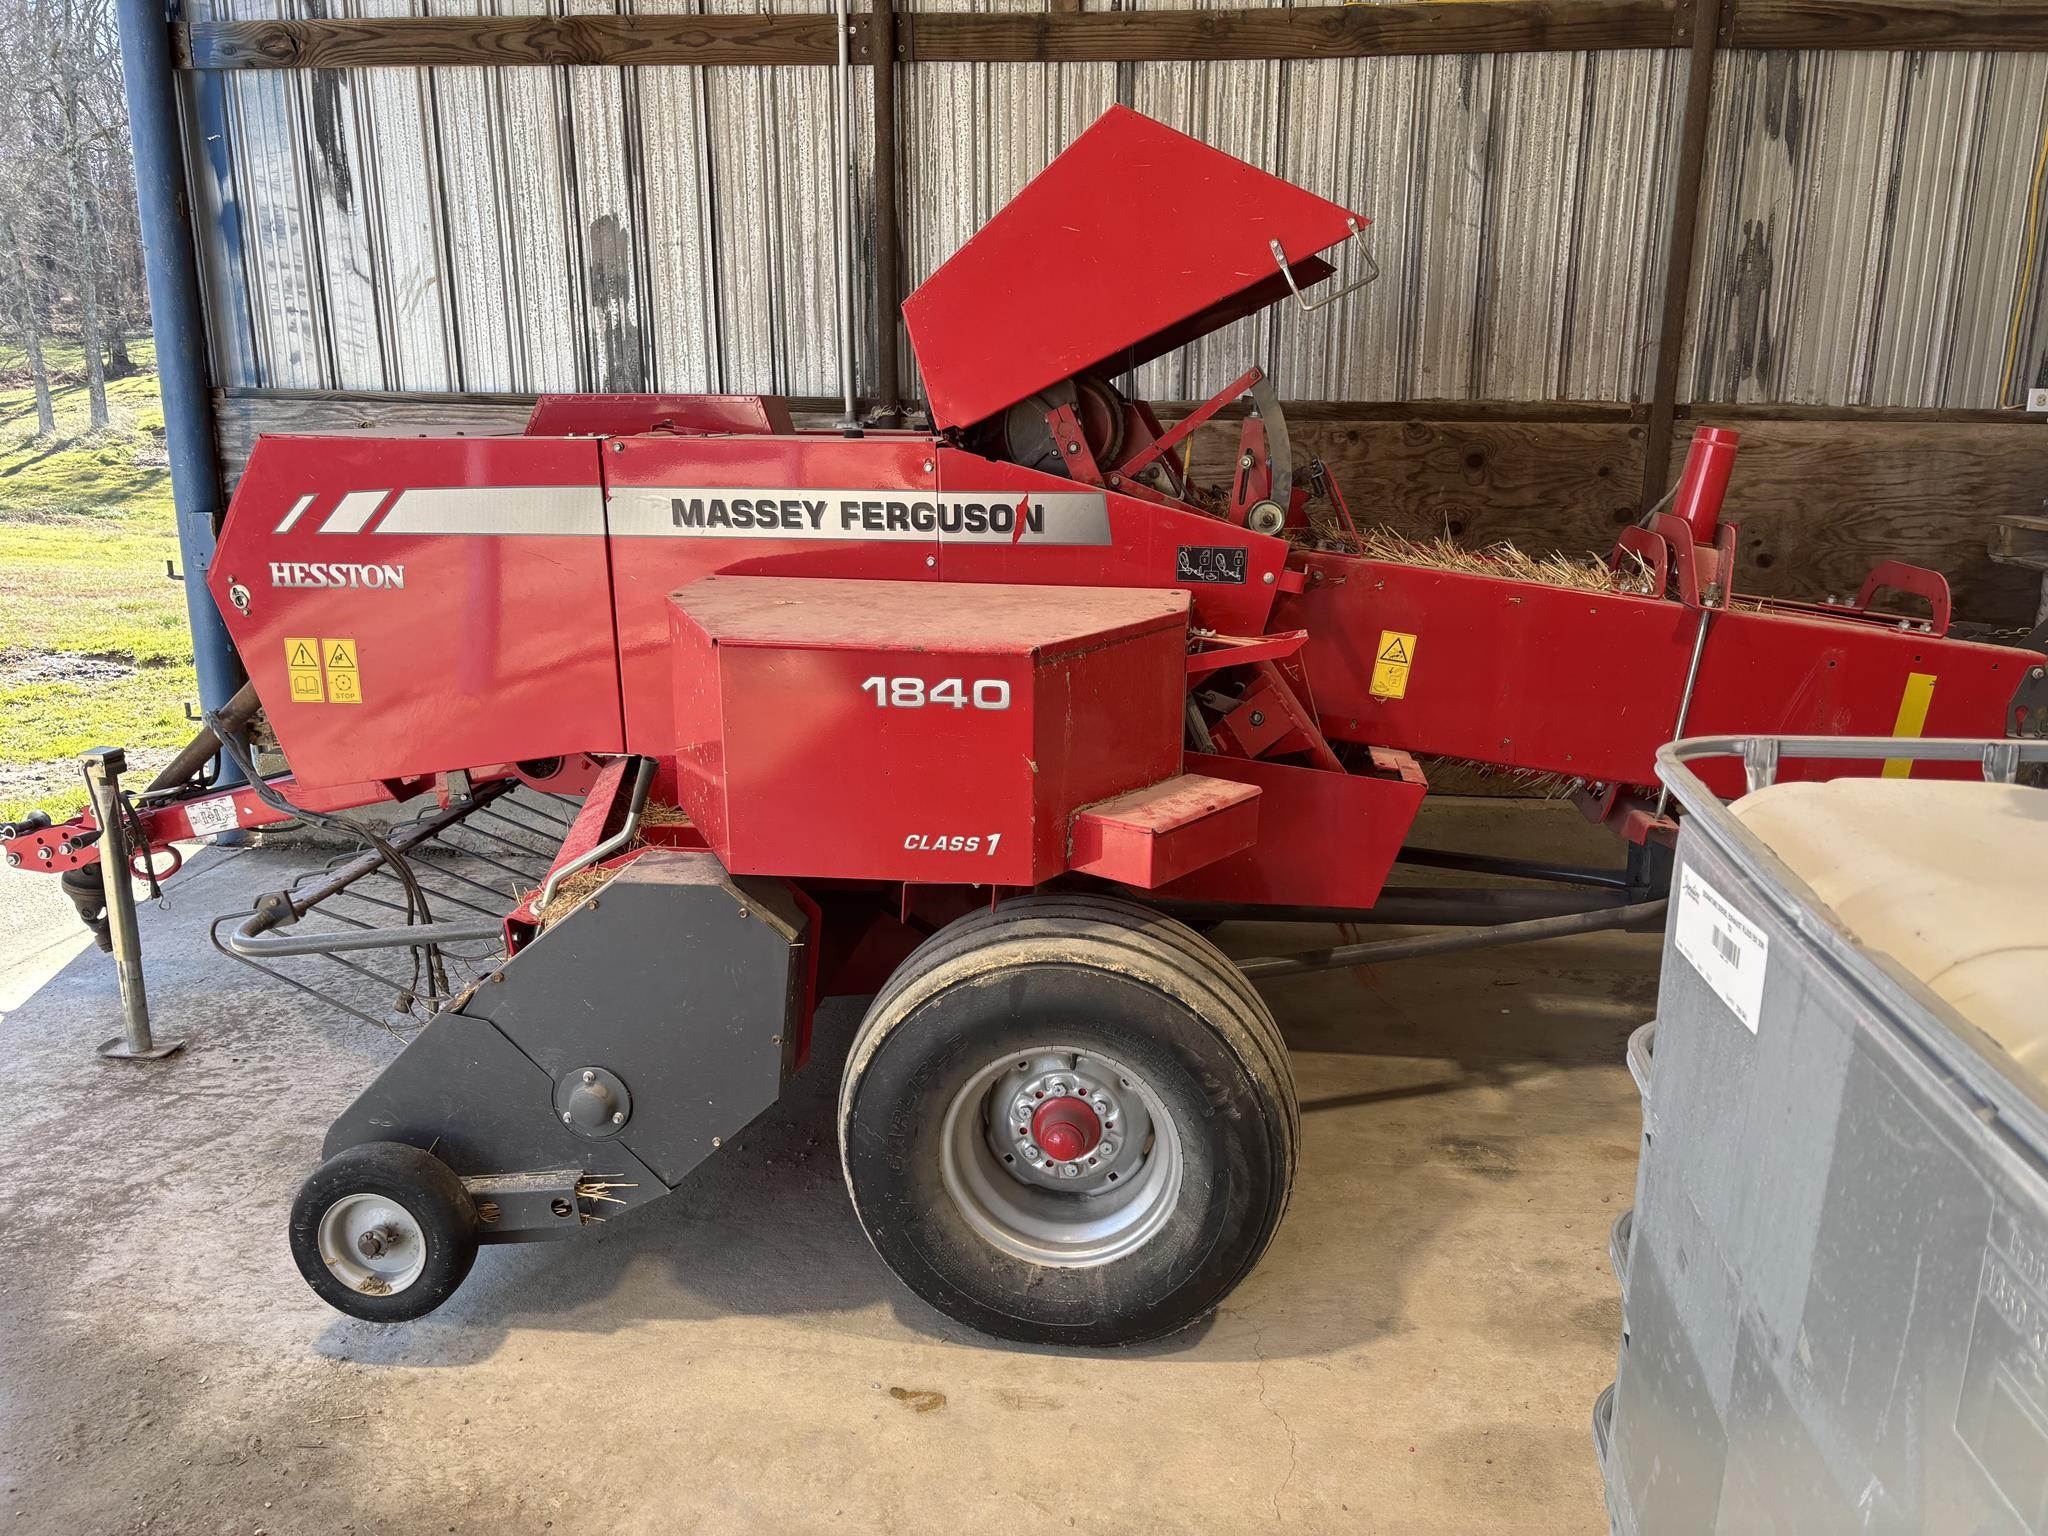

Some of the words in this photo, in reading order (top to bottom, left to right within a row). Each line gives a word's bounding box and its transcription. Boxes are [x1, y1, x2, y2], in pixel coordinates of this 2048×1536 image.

[671, 498, 828, 530] MASSEY
[840, 500, 1045, 534] FERGUSON
[269, 562, 405, 589] HESSTON
[861, 676, 1010, 710] 1840
[903, 834, 981, 852] CLASS
[986, 833, 1002, 856] 1
